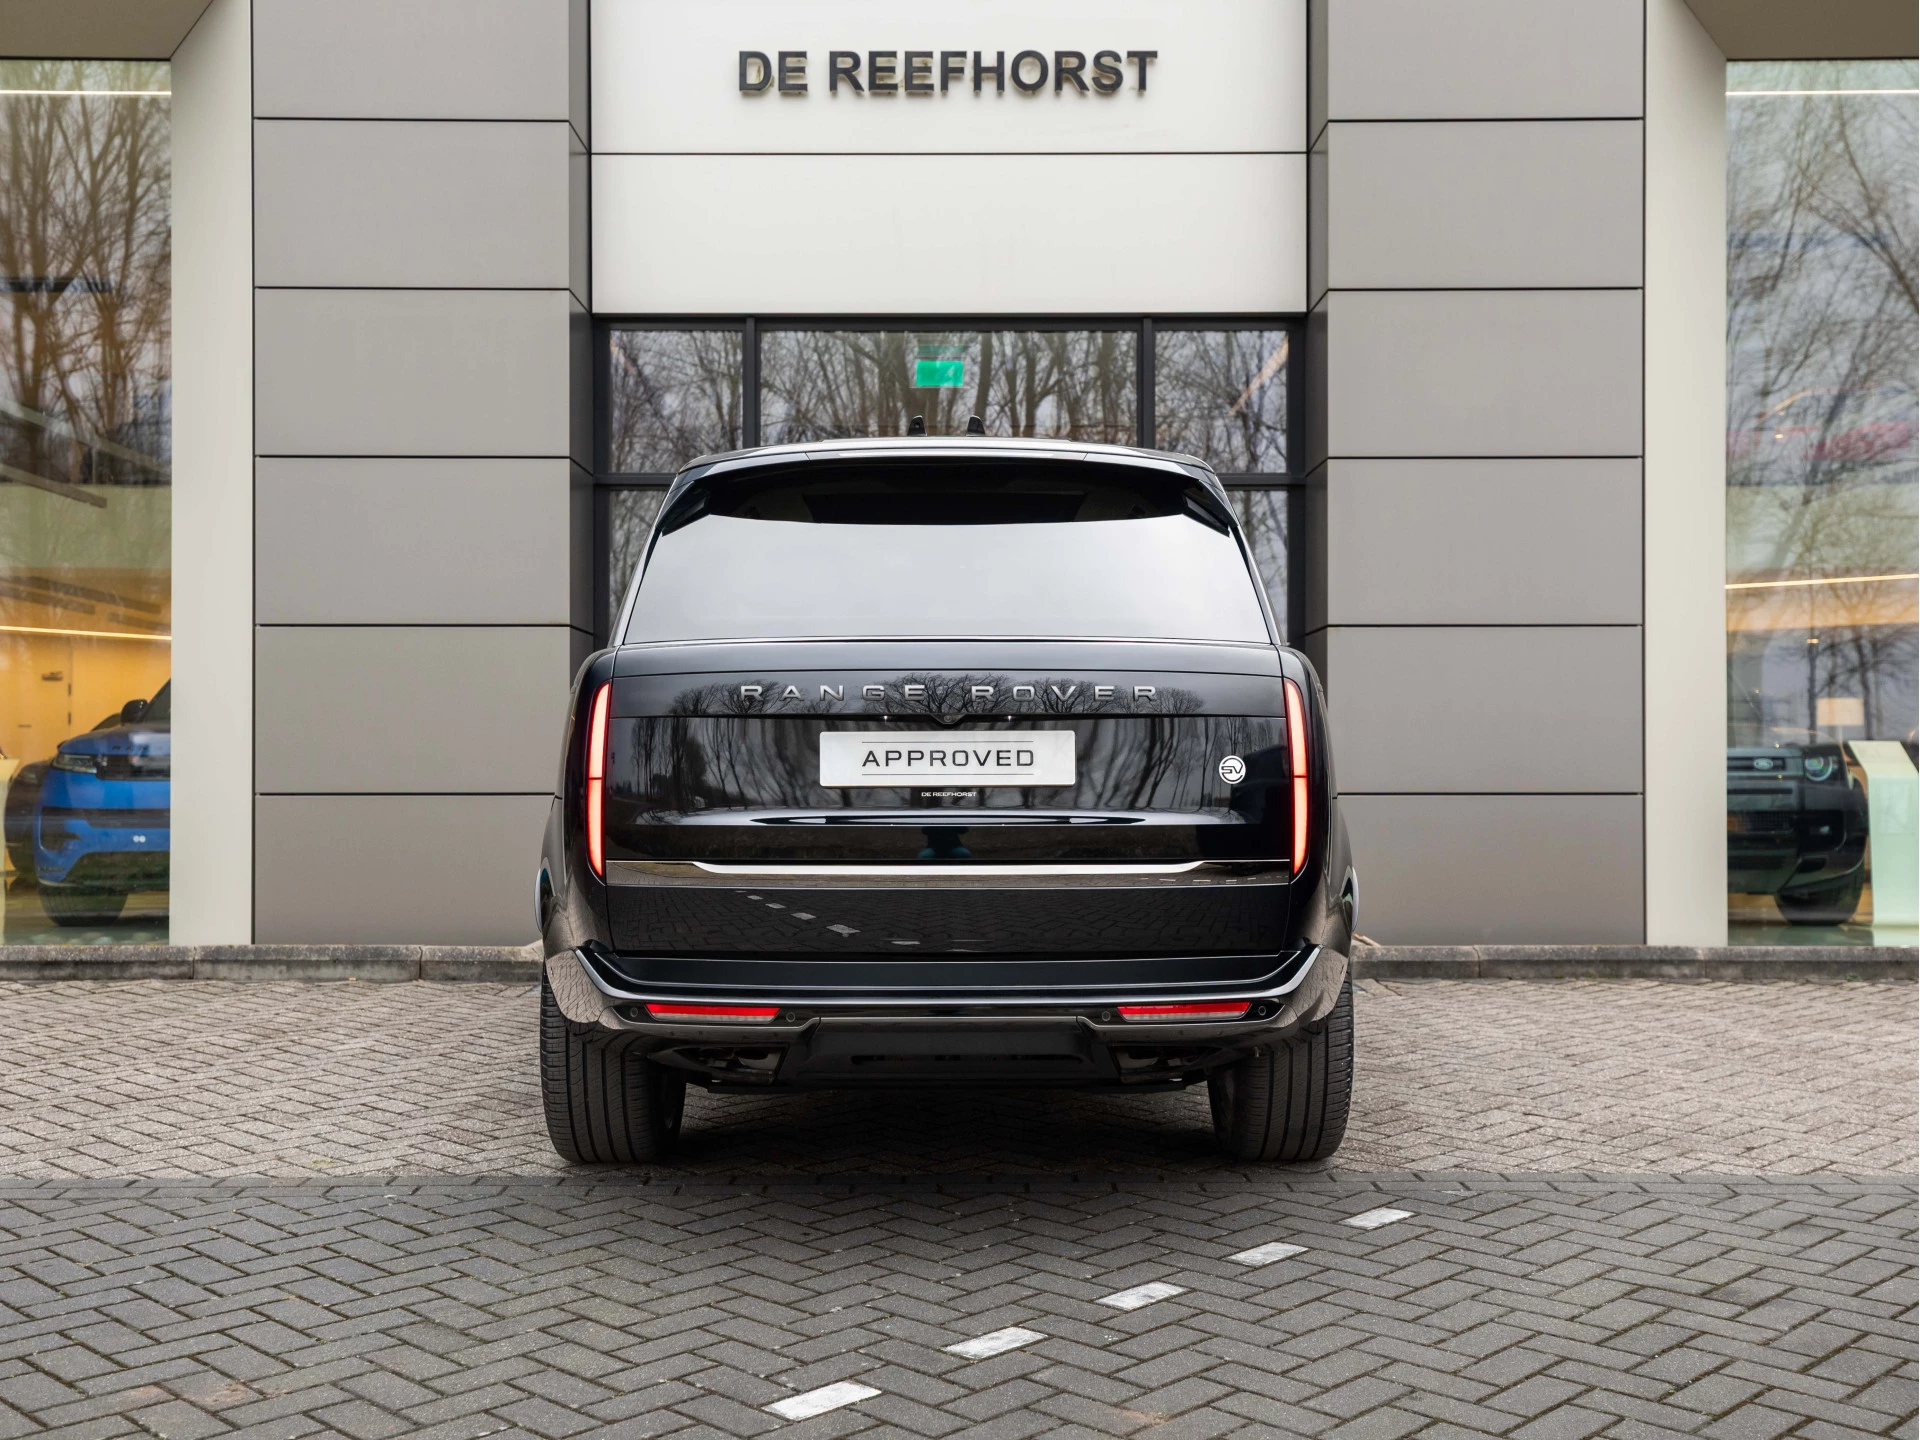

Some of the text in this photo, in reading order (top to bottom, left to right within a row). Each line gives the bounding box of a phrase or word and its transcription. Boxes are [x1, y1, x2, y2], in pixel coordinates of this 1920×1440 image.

[738, 49, 1158, 93] DE REEFHORST
[740, 685, 1158, 701] RANGE ROVER
[861, 749, 1034, 768] APPROVED
